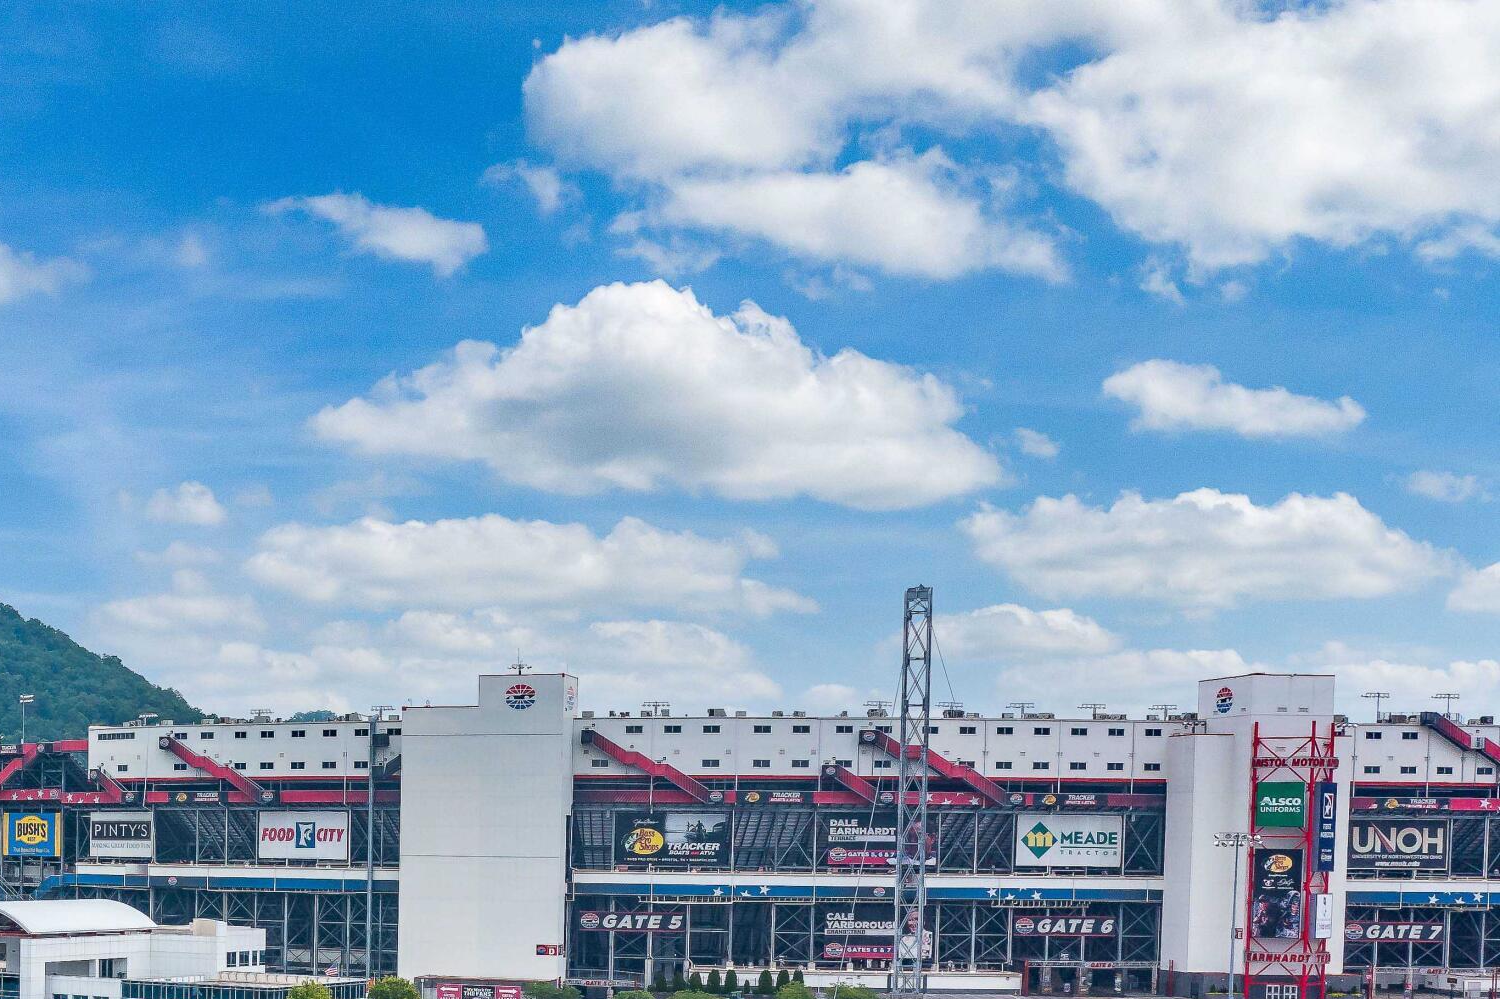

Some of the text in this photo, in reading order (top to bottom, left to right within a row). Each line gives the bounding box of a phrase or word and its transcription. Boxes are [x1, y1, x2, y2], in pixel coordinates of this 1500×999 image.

[1292, 758, 1325, 767] MOTOR
[17, 821, 46, 839] BUSH'S
[94, 823, 149, 837] PINTY'S
[830, 819, 858, 827] DALE
[262, 828, 345, 842] FOOD CITY
[830, 827, 896, 835] EARNHARDT
[1061, 832, 1118, 845] MEADE
[1353, 824, 1443, 853] UNOH
[667, 842, 720, 850] TRACKER
[603, 914, 683, 929] GATE 5
[1038, 918, 1115, 934] GATE 6
[1366, 925, 1443, 939] GATE 7
